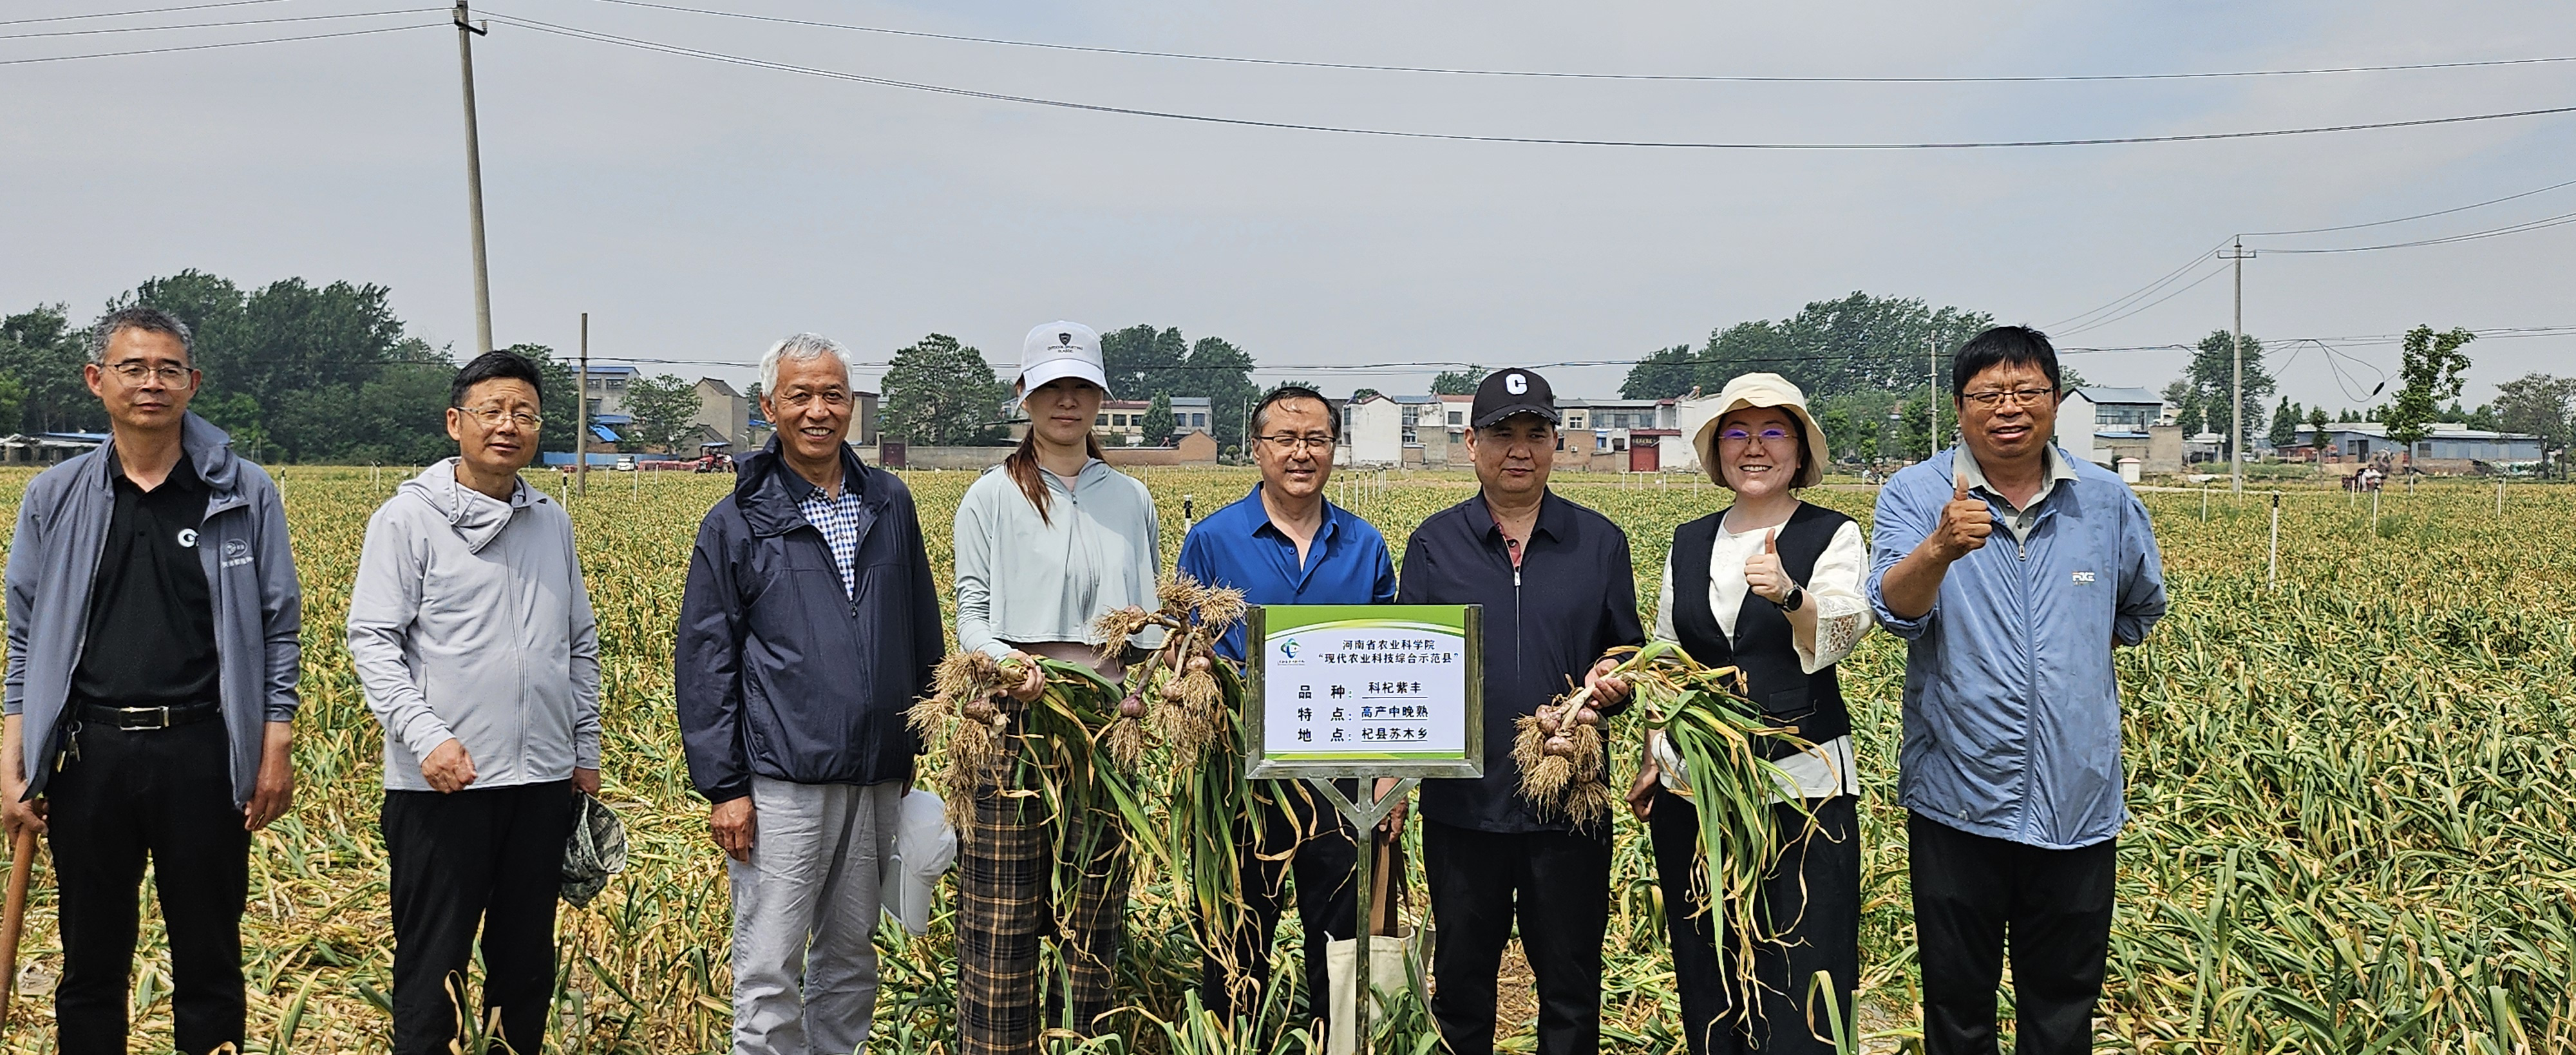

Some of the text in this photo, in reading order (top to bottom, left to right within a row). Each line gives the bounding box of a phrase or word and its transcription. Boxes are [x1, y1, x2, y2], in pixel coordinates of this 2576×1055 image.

[1506, 374, 1528, 395] C
[1342, 639, 1435, 651] 河南省农业科学院
[1318, 652, 1459, 664] “现代农业科技综合示范县”
[1368, 681, 1422, 694] 科杞紫丰
[1361, 705, 1428, 718] 高产中晚熟
[1361, 727, 1428, 739] 杞县苏木乡
